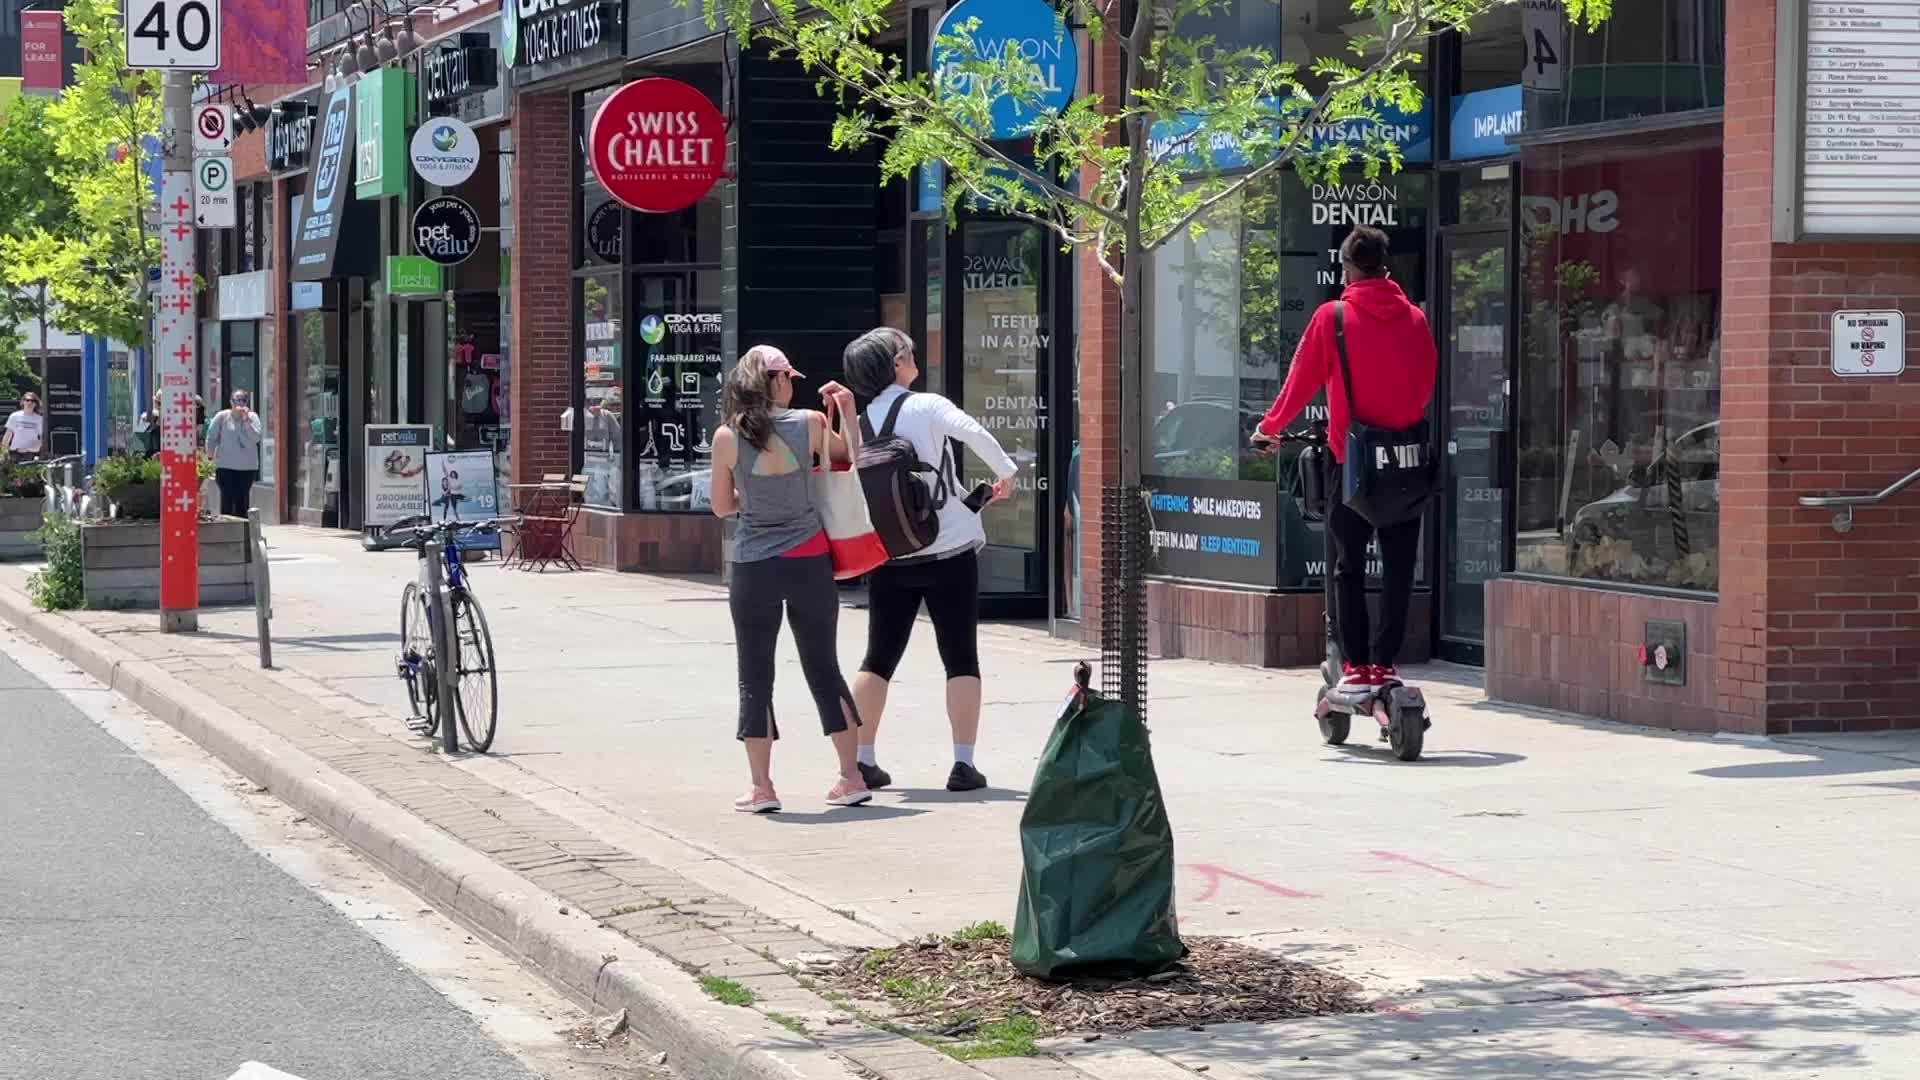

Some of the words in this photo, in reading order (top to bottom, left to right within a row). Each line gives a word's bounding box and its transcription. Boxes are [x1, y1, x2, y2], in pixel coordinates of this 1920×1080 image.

[133, 1, 211, 51] 40
[523, 20, 550, 64] YOGA
[551, 15, 560, 58] &
[562, 1, 600, 54] FITNESS
[25, 42, 46, 50] FOR
[25, 53, 57, 62] LEASE
[627, 111, 699, 136] SWISS
[416, 155, 474, 164] OXYGEN
[607, 132, 713, 172] CHALET
[208, 168, 220, 184] P
[1312, 184, 1397, 200] DAWSON
[201, 196, 210, 204] 20
[212, 196, 228, 204] min
[1312, 203, 1398, 225] DENTAL
[418, 222, 450, 247] pet
[426, 233, 469, 255] valu
[1317, 271, 1335, 285] IN
[668, 324, 692, 333] YOGA
[694, 324, 701, 333] &
[991, 315, 1039, 328] TEETH
[981, 336, 998, 348] IN
[1003, 336, 1015, 348] A
[1019, 336, 1050, 348] DAY
[650, 354, 704, 363] FAR-INFRARED
[985, 397, 1047, 409] DENTAL
[376, 494, 424, 502] GROOMING
[1151, 494, 1189, 512] WHITENING
[1192, 496, 1215, 516] SMILE
[1215, 499, 1261, 520] MAKEOVERS
[1185, 533, 1199, 551] DAY
[1200, 535, 1222, 553] SLEEP
[1222, 537, 1261, 557] DENTISTRY
